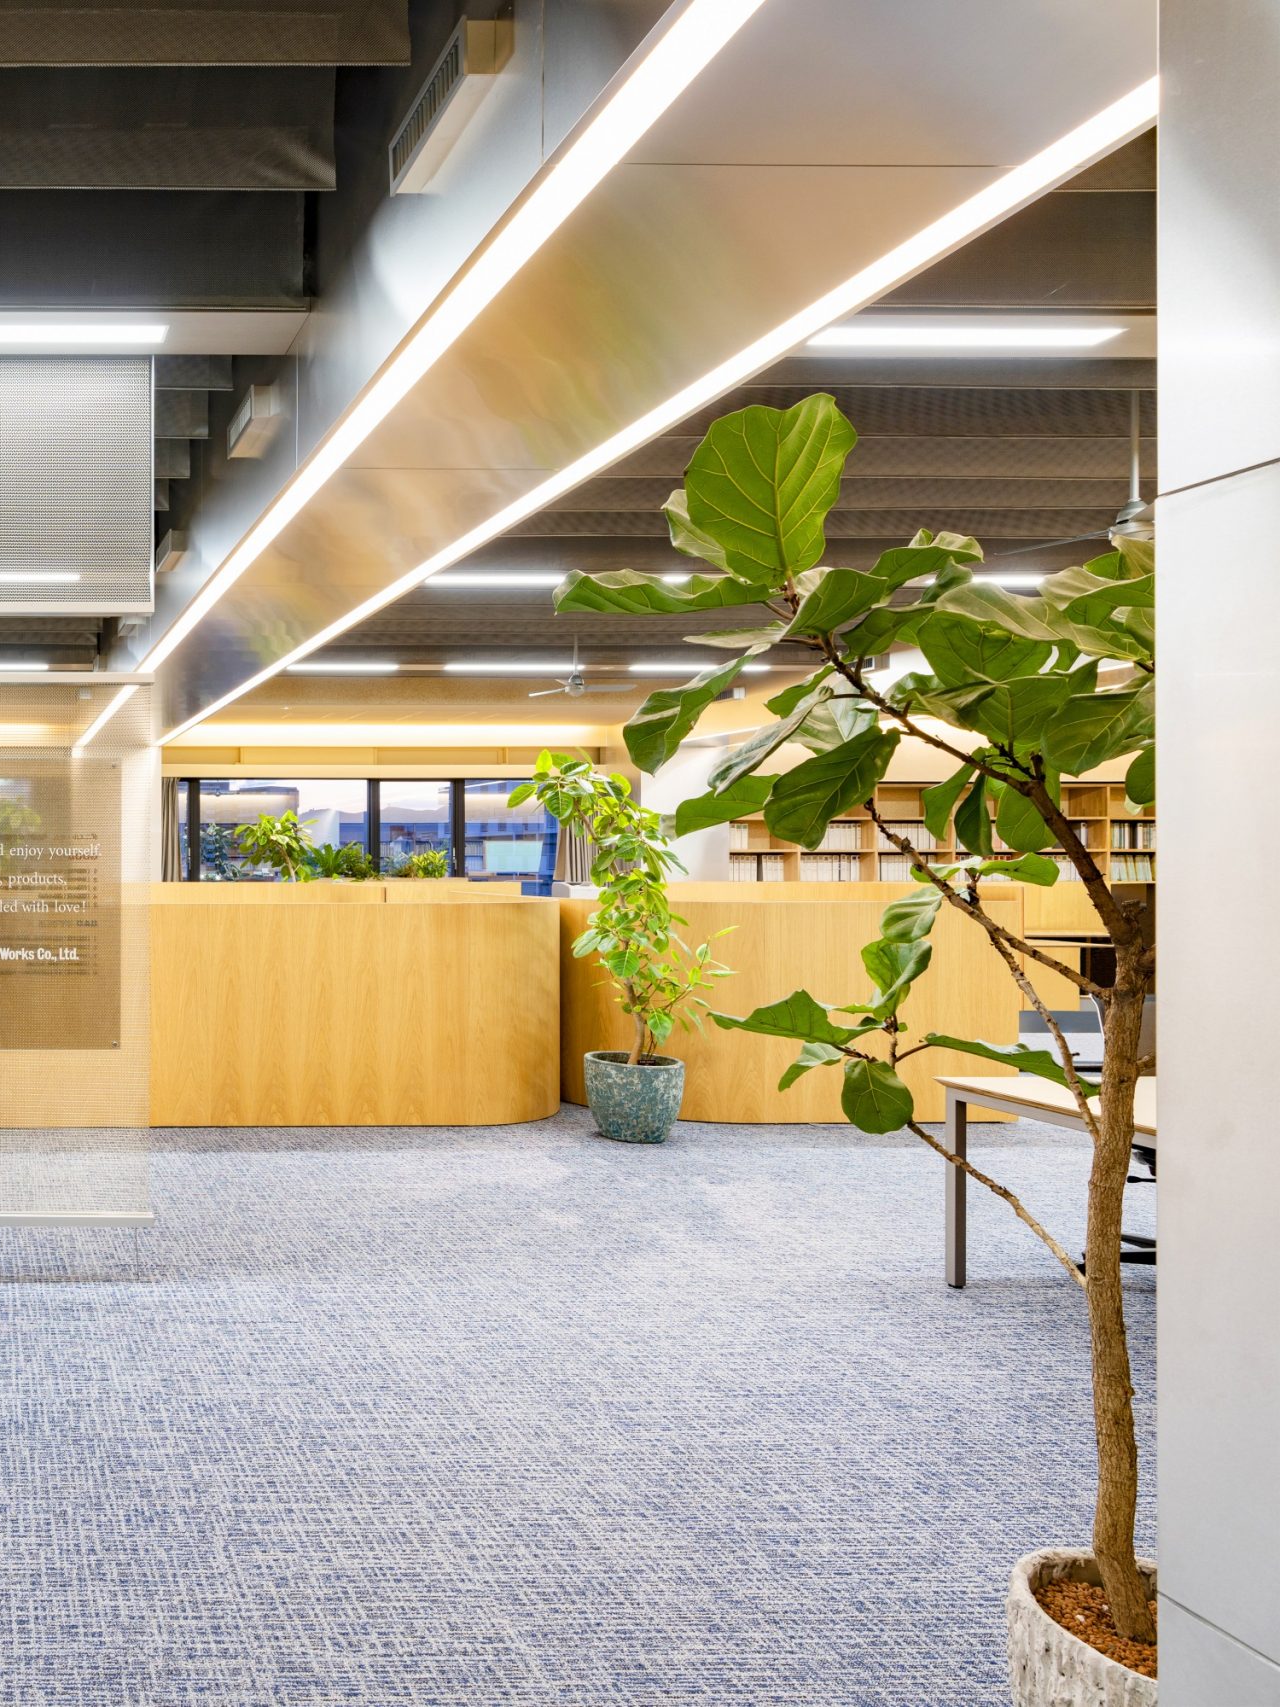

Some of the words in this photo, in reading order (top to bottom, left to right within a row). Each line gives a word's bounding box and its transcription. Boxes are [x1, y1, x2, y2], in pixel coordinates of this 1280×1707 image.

[10, 845, 44, 860] enjoy
[49, 843, 102, 860] yourself.
[22, 900, 48, 912] with
[54, 900, 86, 912] love!
[0, 948, 34, 960] Works
[37, 948, 57, 962] Co.,
[59, 948, 80, 960] Ltd.
